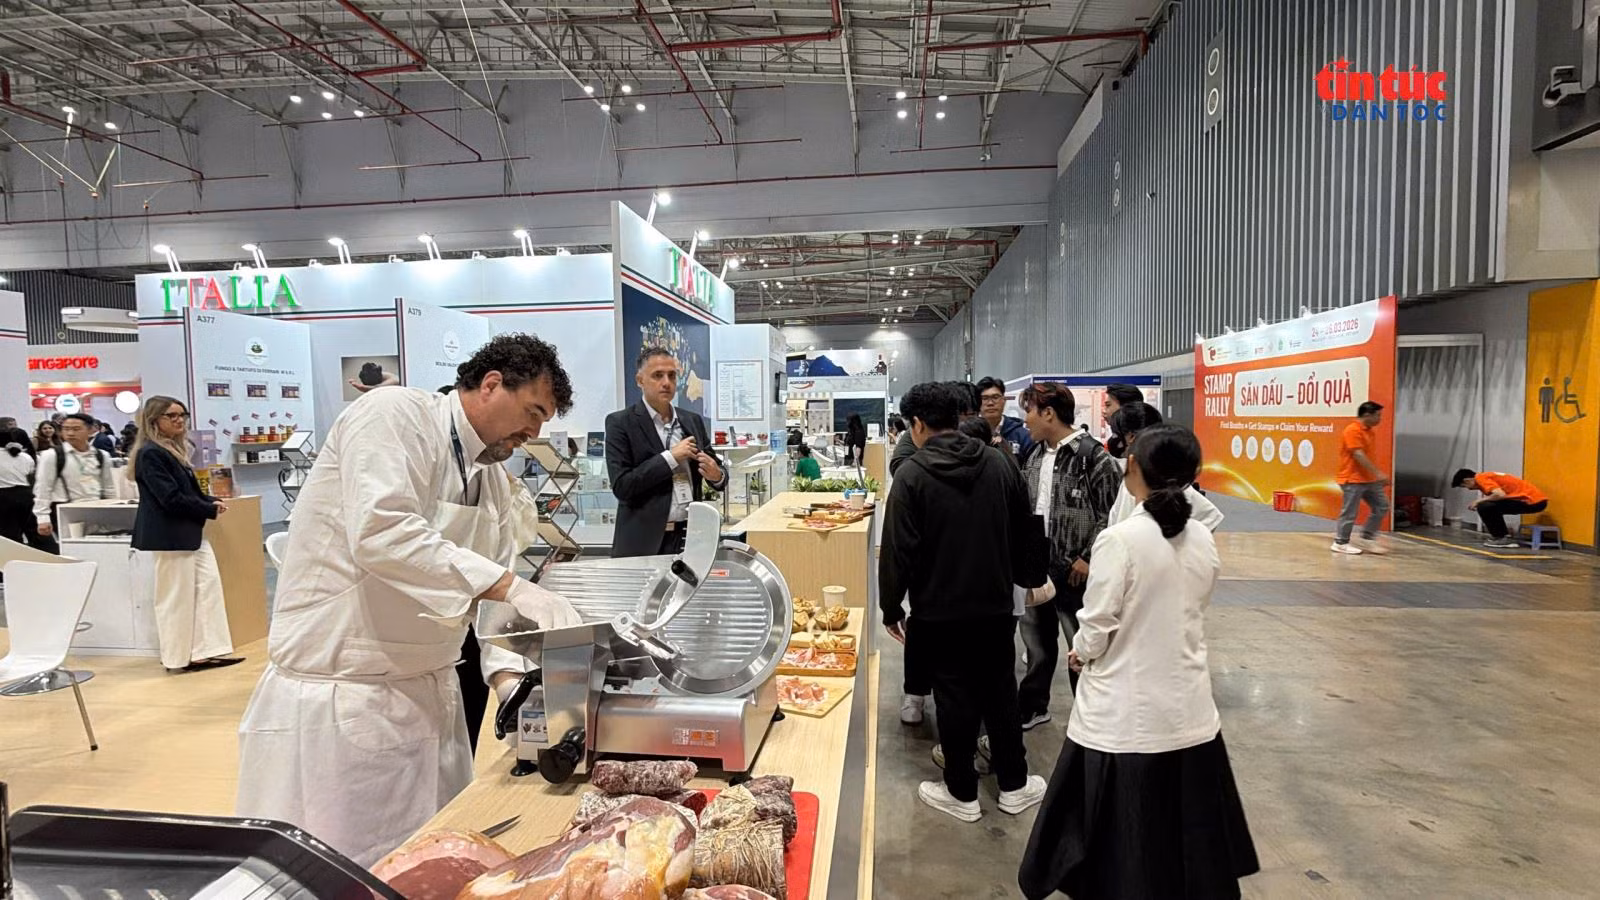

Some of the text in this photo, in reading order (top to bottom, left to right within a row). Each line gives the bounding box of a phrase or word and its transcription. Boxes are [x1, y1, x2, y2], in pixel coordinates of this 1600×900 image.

[161, 273, 299, 313] ITALIA
[197, 315, 215, 324] A377
[1204, 373, 1233, 395] STAMP
[1262, 377, 1283, 406] DẤU
[1297, 371, 1319, 405] ĐỔI
[1323, 370, 1352, 407] QUÀ
[1205, 396, 1231, 417] RALLY
[1280, 422, 1295, 431] Claim
[1296, 423, 1309, 432] Your
[1309, 422, 1334, 433] Reward
